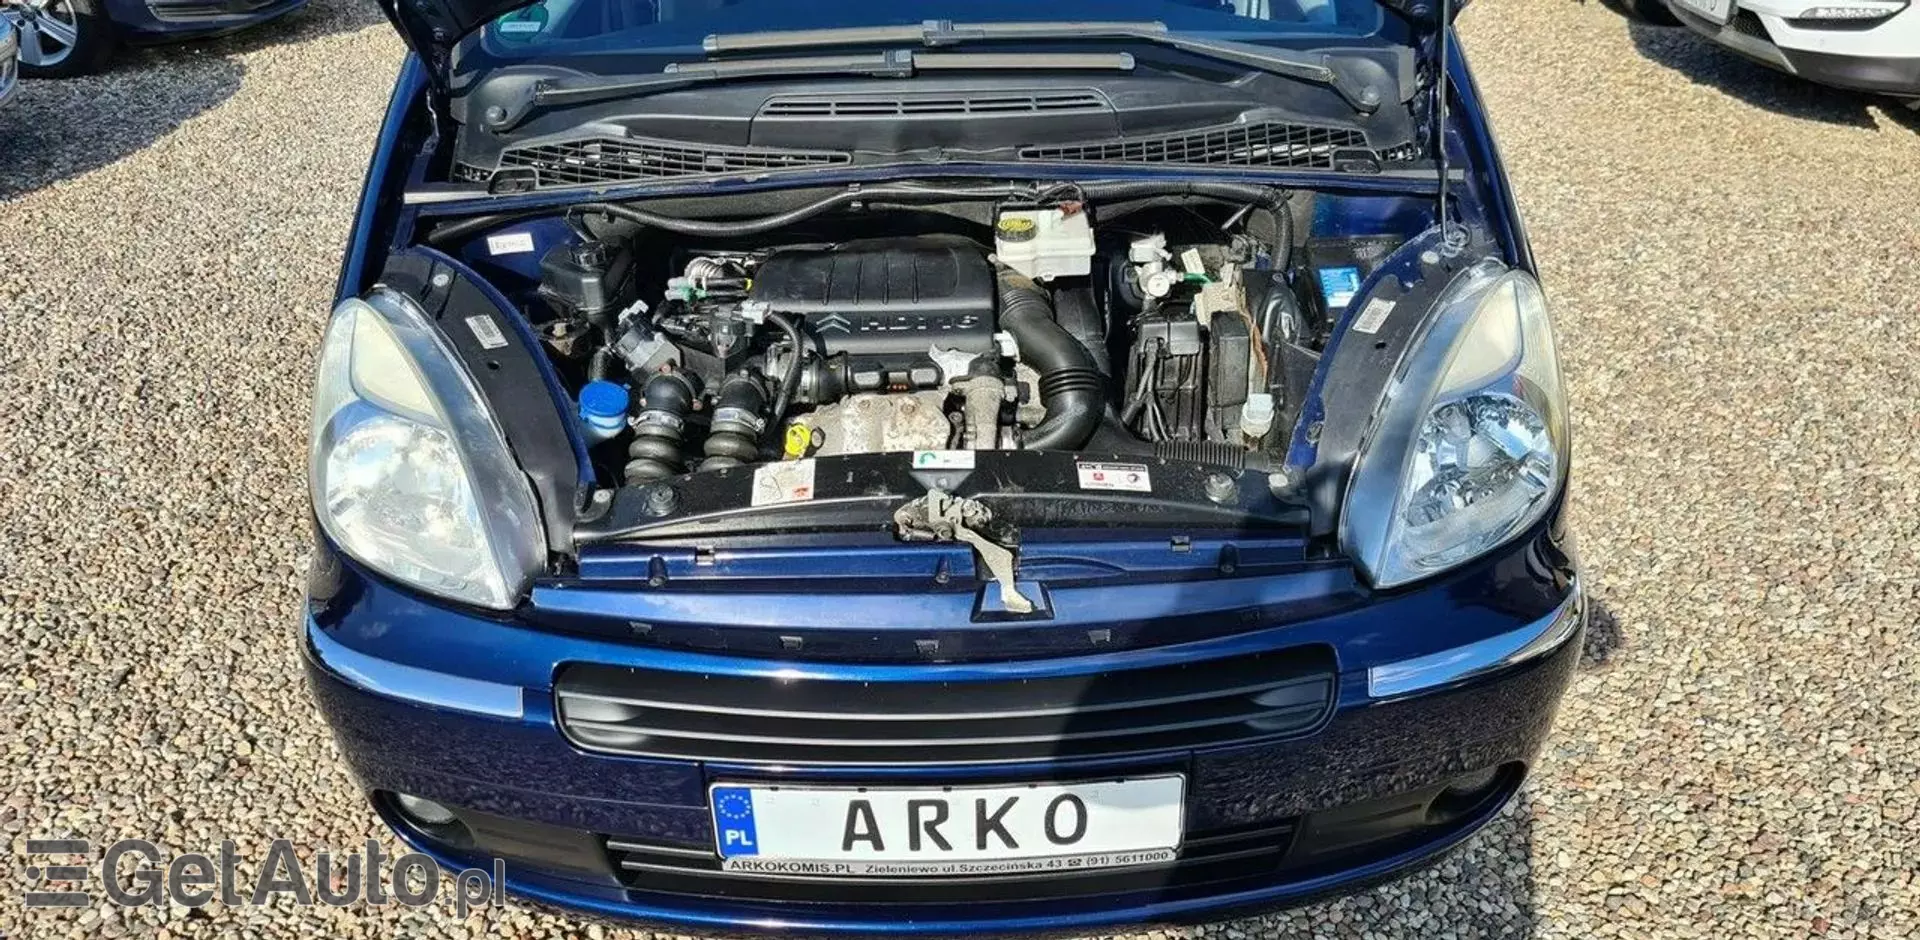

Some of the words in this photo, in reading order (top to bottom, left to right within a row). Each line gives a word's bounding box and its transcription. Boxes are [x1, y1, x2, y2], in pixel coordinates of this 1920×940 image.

[841, 793, 1089, 852] ARKO
[725, 829, 753, 846] PL
[730, 859, 854, 874] ARKOKOMIS.PL
[865, 863, 938, 874] Zieleniewo
[1046, 859, 1063, 869] 43
[1086, 855, 1110, 867] (91)
[1115, 851, 1169, 864] 5611000
